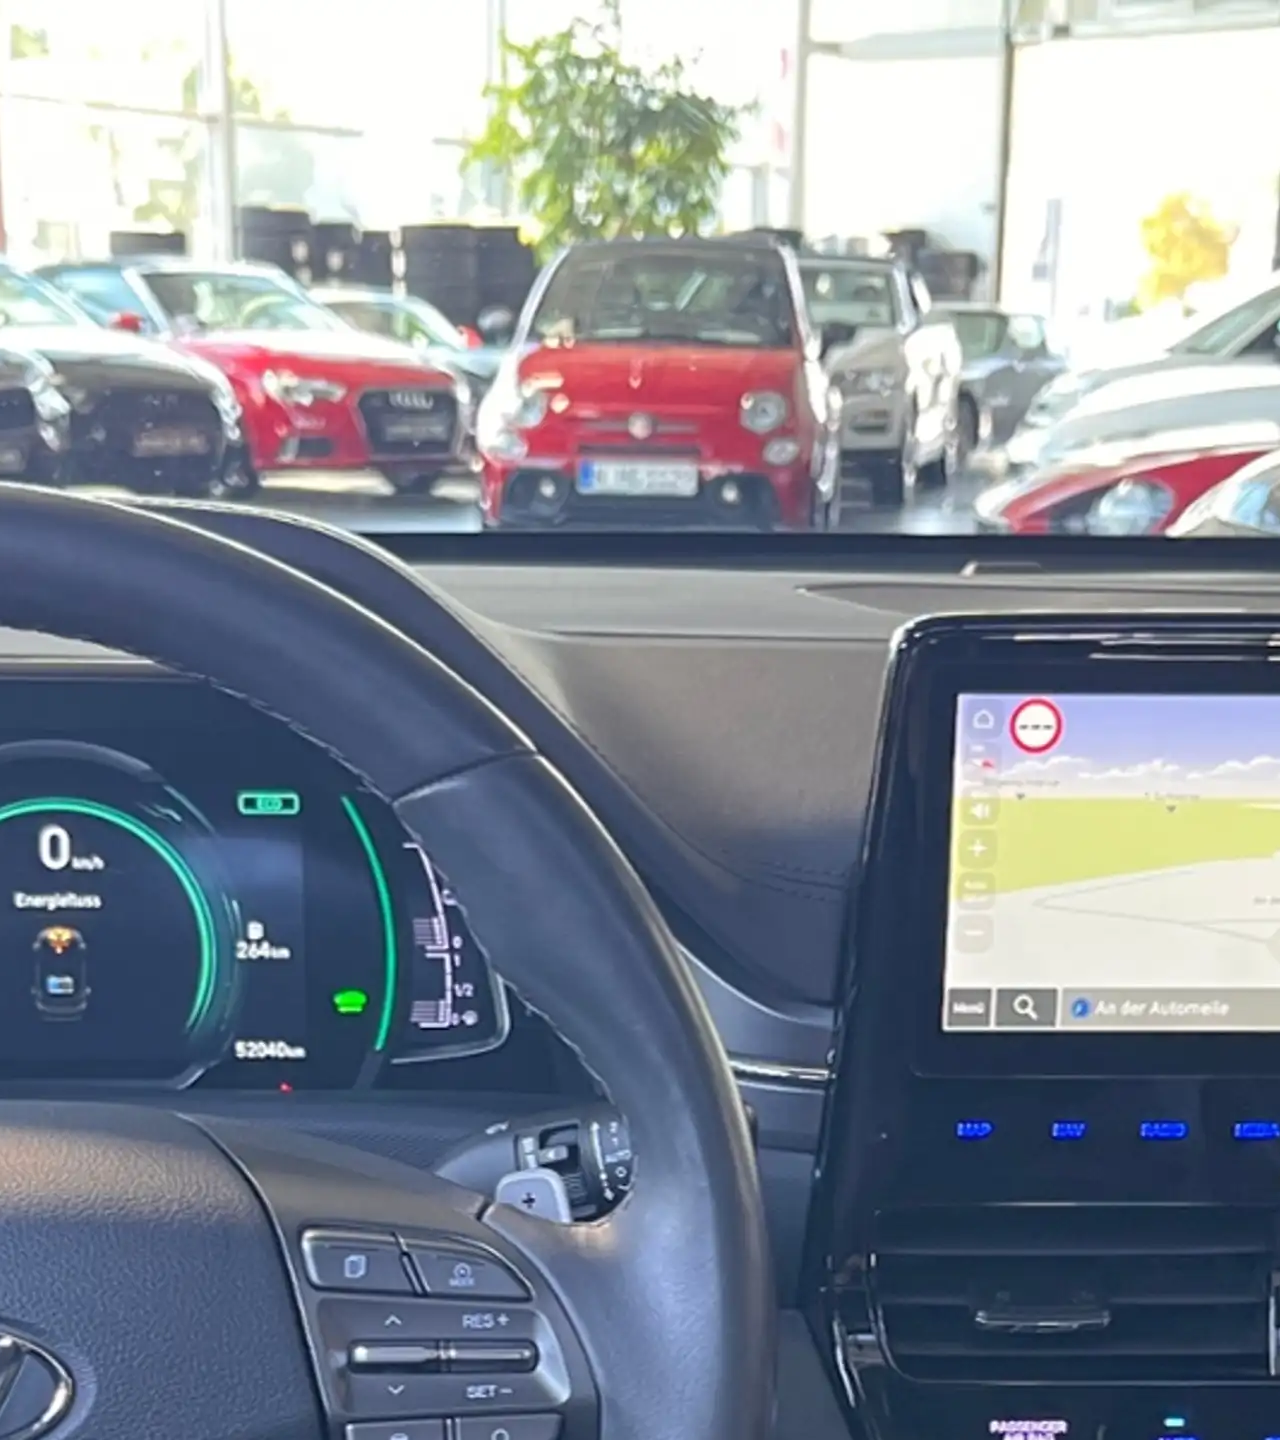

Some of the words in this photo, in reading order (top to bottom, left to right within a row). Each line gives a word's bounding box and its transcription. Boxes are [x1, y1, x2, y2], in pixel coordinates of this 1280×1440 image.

[38, 823, 70, 870] 0
[71, 853, 105, 871] km/h
[13, 890, 102, 911] Energiefluss
[1095, 1000, 1117, 1016] An
[1120, 1000, 1145, 1016] der
[1149, 1000, 1230, 1017] Automeile
[462, 1313, 494, 1329] RES
[466, 1383, 497, 1399] SET
[989, 1420, 1068, 1434] PASSENGER
